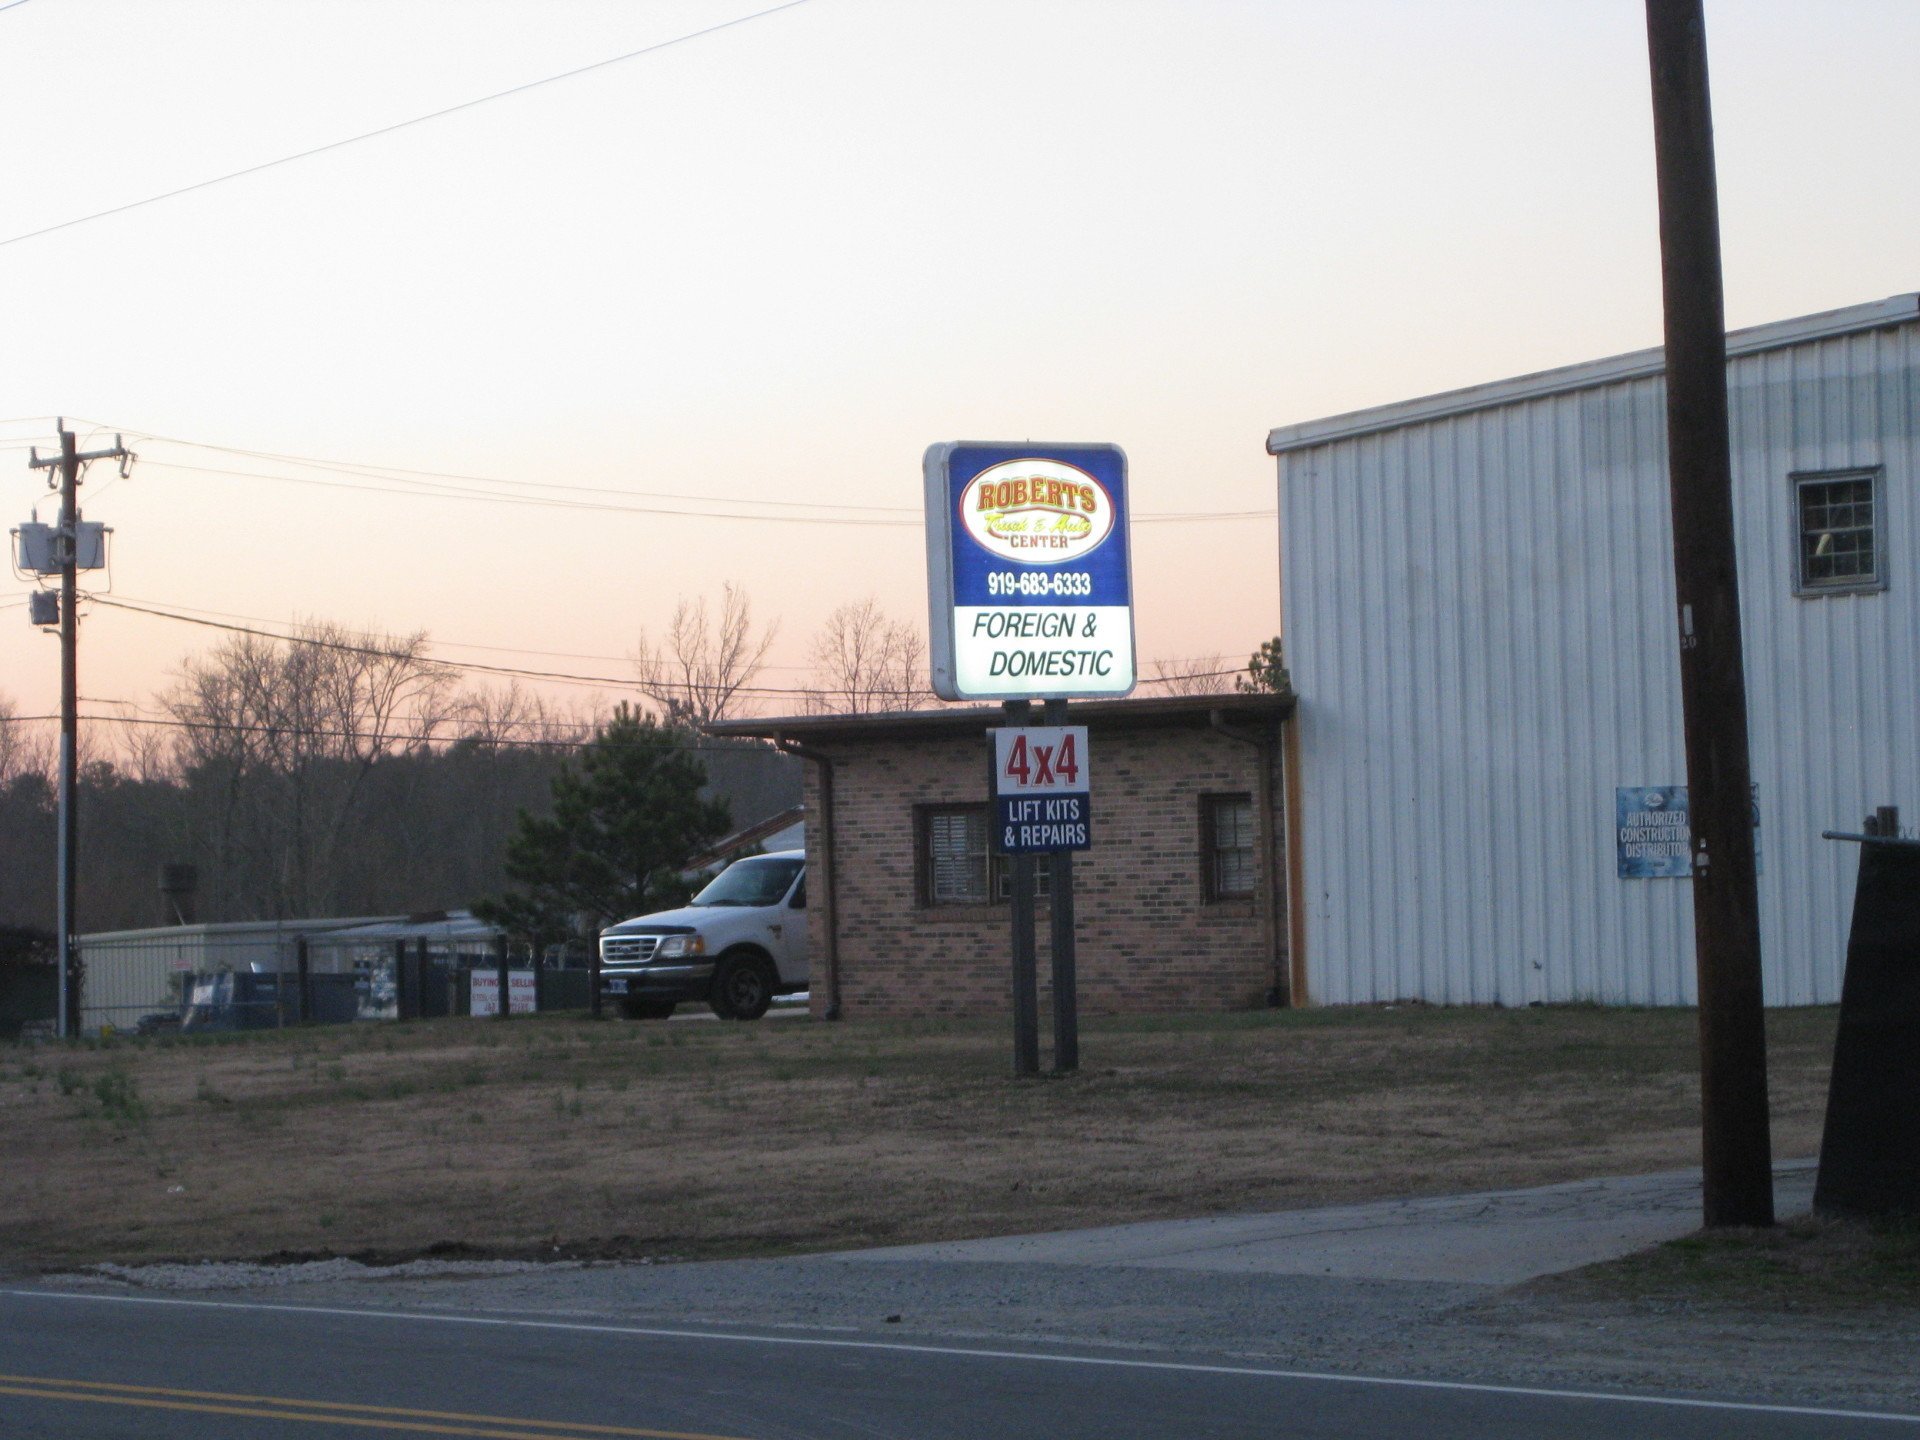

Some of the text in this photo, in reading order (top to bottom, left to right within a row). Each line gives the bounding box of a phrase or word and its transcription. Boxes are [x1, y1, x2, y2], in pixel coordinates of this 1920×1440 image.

[976, 475, 1097, 514] ROBERTS
[984, 513, 1029, 533] Truck
[1050, 514, 1092, 533] Auto
[1010, 535, 1069, 549] CENTER
[988, 572, 1091, 595] 919-683-6333
[972, 612, 1097, 638] FOREIGN &
[989, 650, 1113, 677] DOMESTIC
[1009, 799, 1080, 821] LIFT KITS
[1626, 810, 1686, 827] AUTHORIZED
[1004, 823, 1086, 847] & REPAIRS
[1620, 826, 1692, 842] CONSTRUCTION
[511, 978, 536, 988] SELLIN
